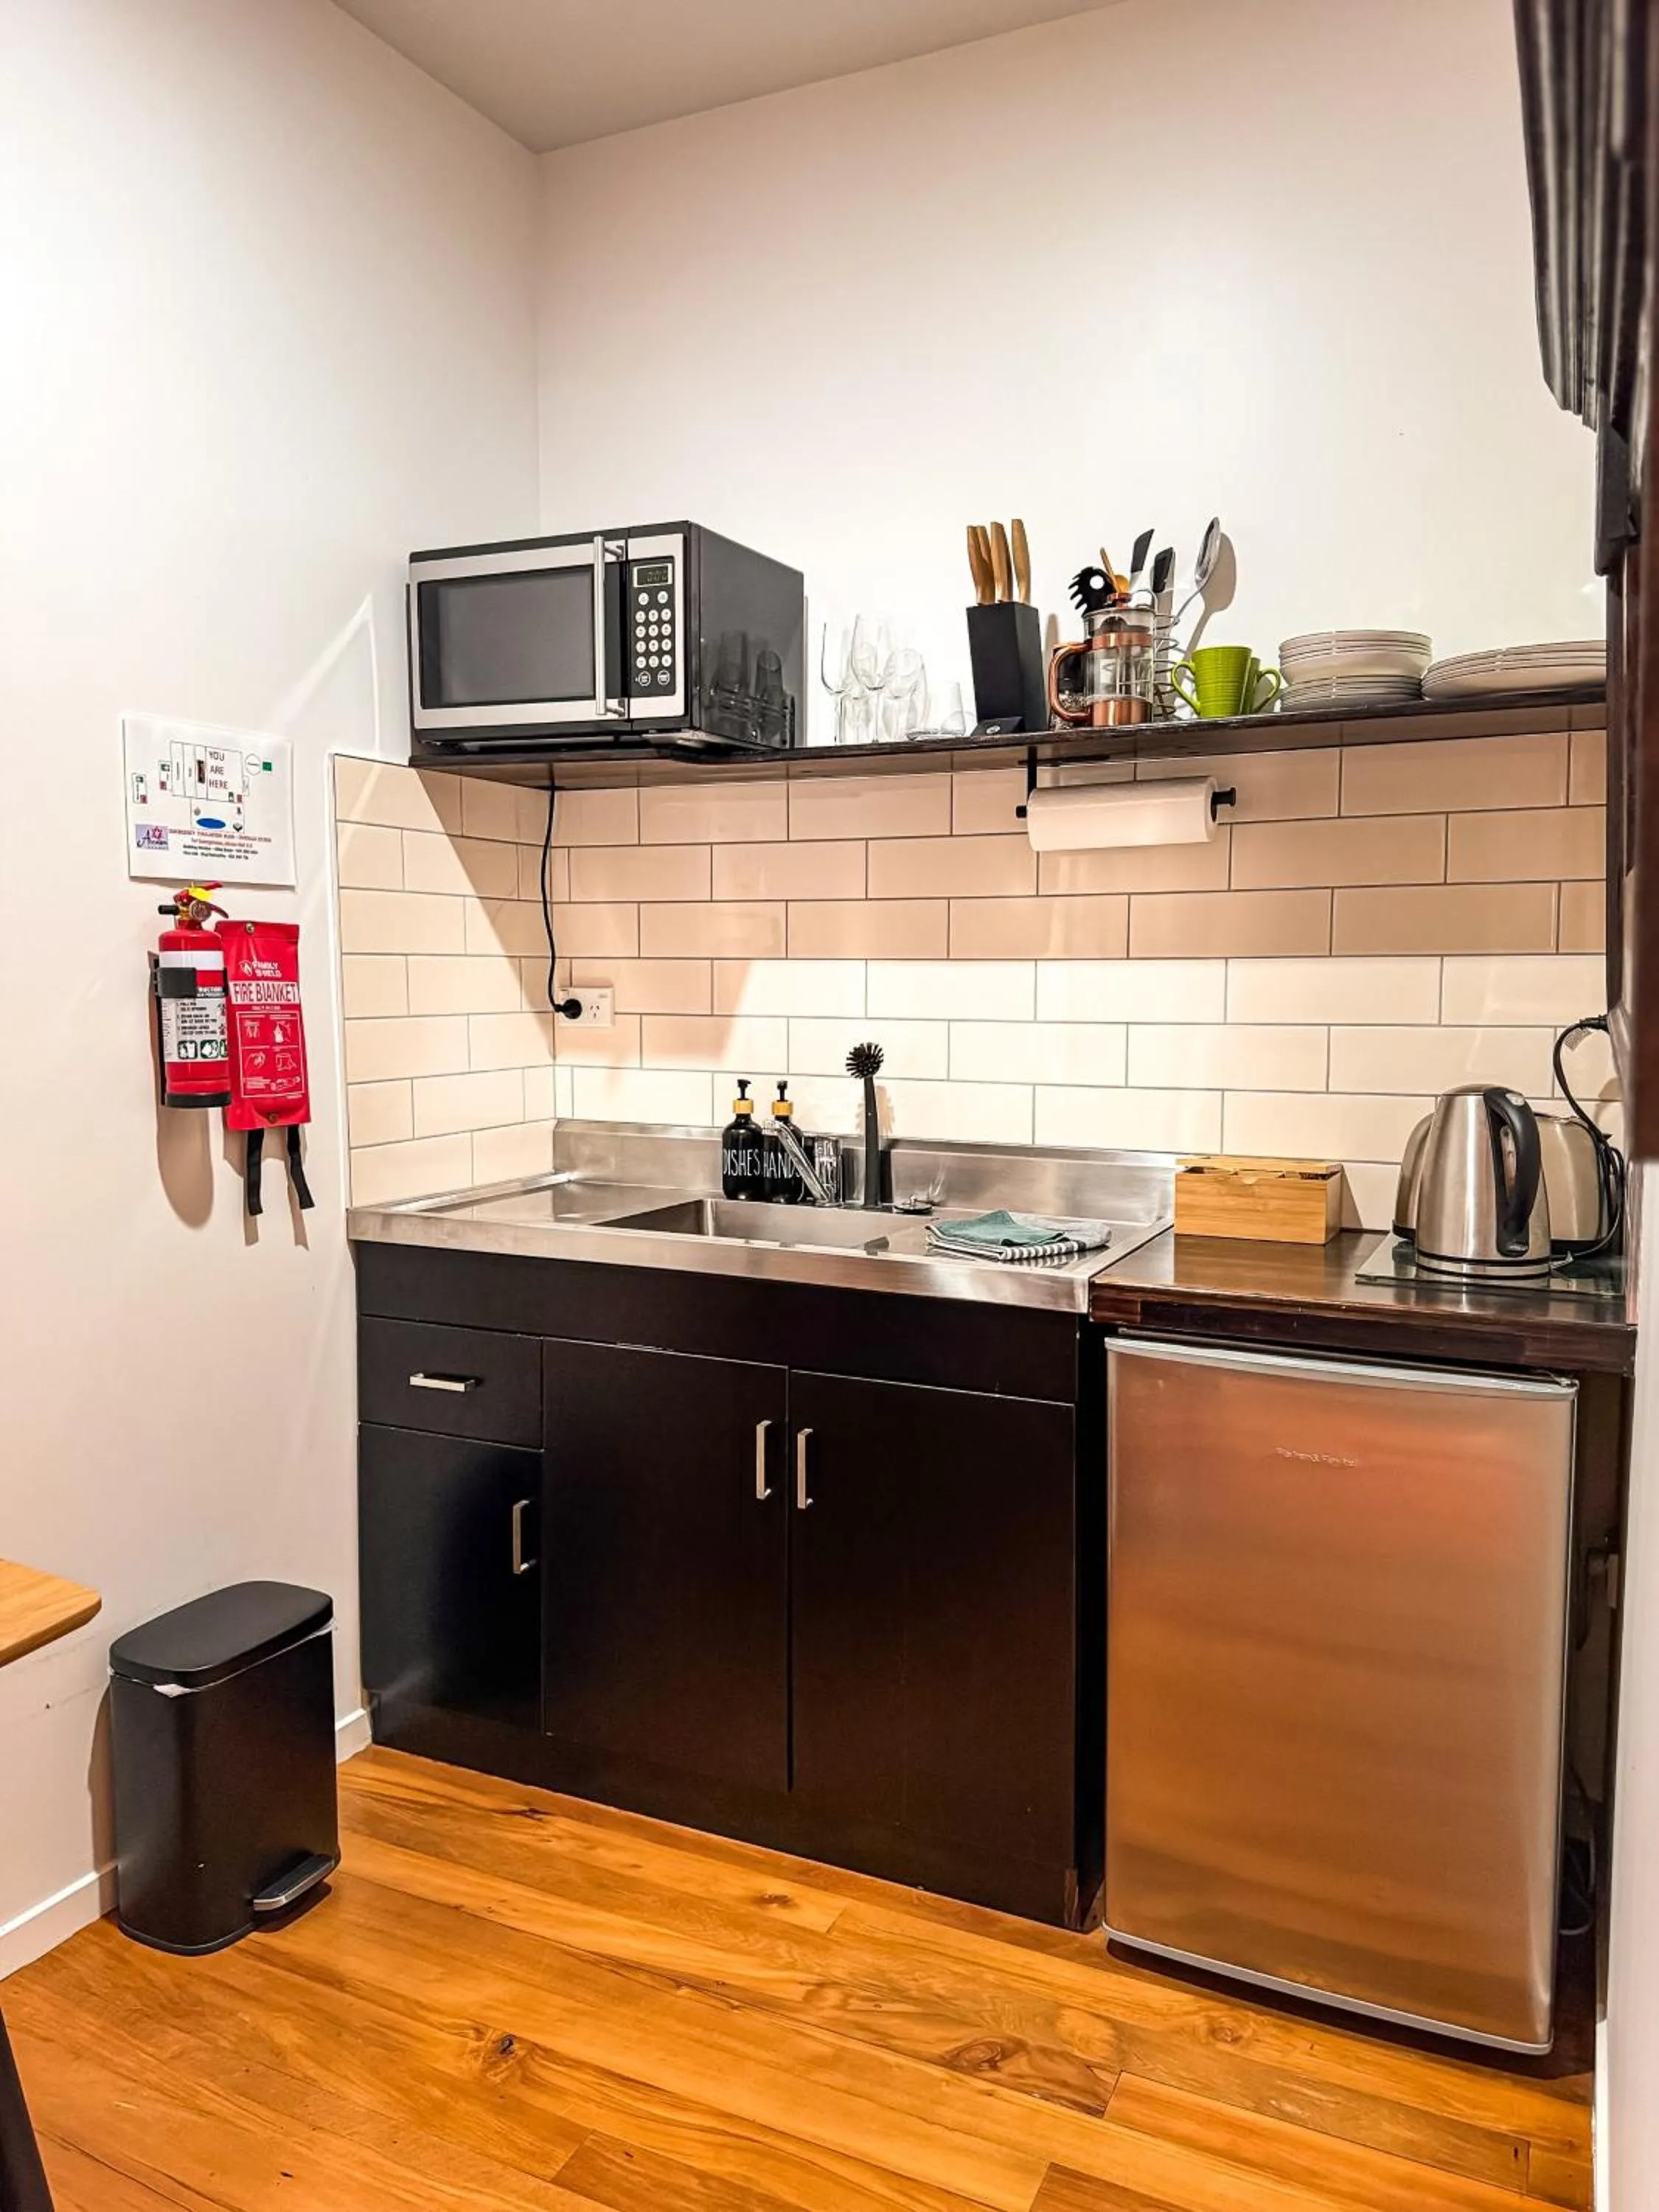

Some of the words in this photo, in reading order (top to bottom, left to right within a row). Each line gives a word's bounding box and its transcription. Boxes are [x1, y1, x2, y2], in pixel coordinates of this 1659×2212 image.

[208, 751, 225, 761] YOU
[209, 765, 224, 775] ARE
[209, 779, 228, 790] HERE
[232, 982, 254, 1002] FIRE
[256, 982, 296, 1002] BLANKET
[723, 1148, 760, 1176] DISHES
